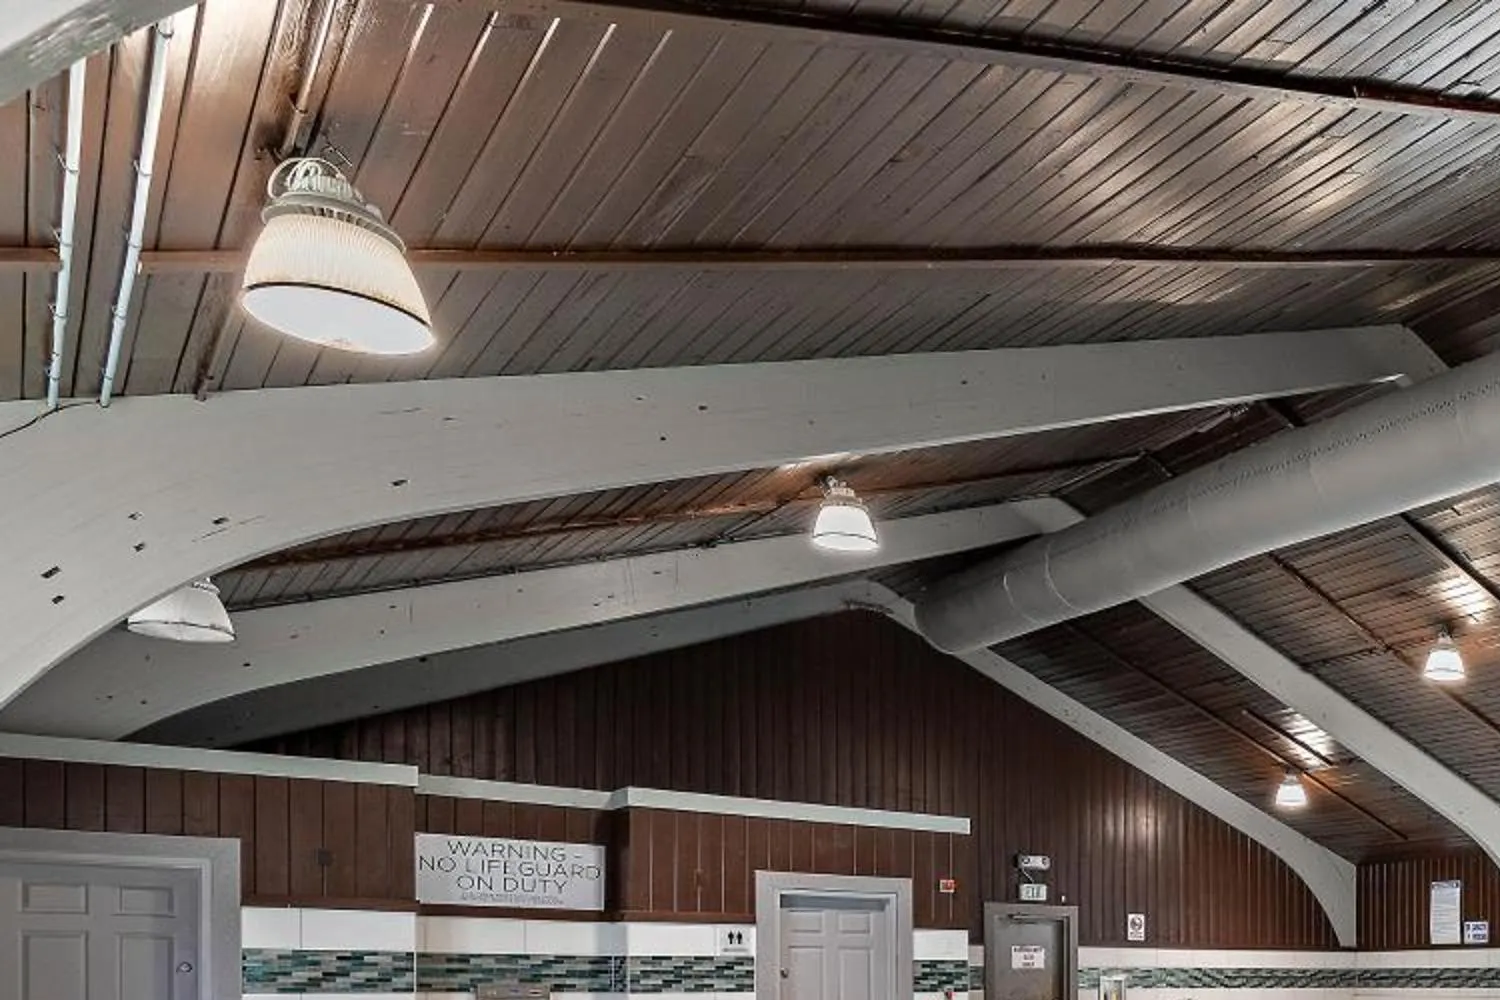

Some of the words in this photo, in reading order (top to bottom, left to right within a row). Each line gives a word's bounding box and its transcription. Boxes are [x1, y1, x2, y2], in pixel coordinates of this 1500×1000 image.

[447, 840, 567, 862] WARNING
[419, 855, 457, 872] NO
[466, 859, 601, 880] LIFEGUARD
[457, 875, 493, 891] ON
[503, 877, 567, 894] DUTY
